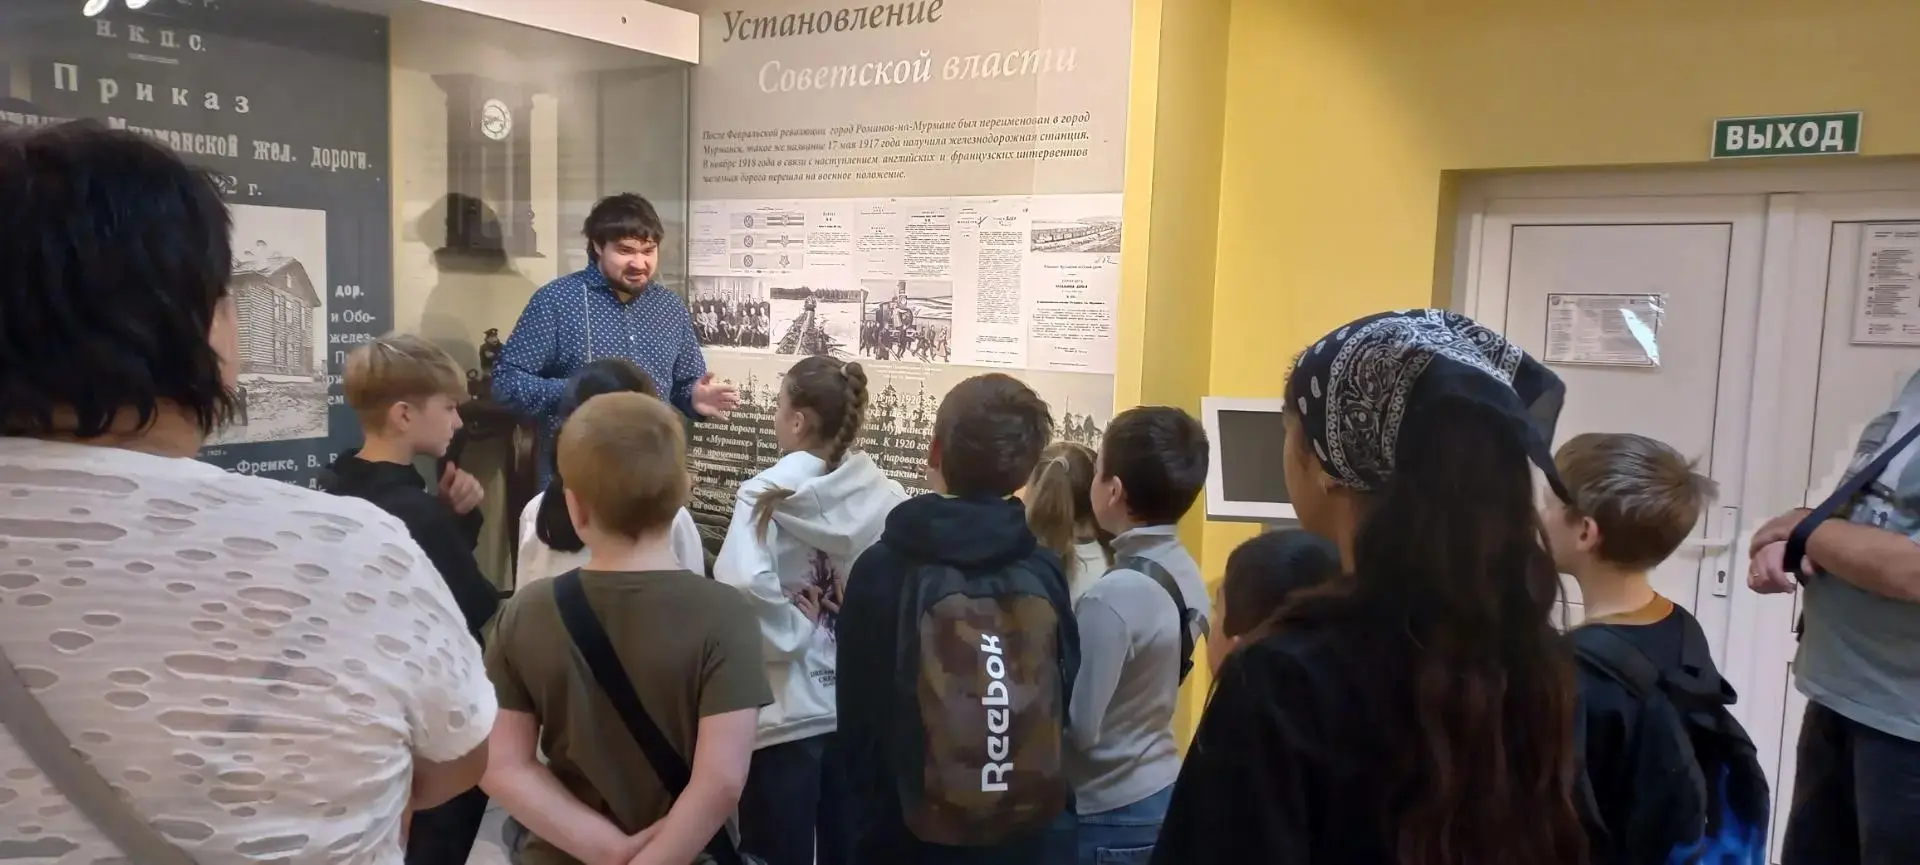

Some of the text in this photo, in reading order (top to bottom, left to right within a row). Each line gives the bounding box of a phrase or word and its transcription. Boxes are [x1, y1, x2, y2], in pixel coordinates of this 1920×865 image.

[723, 0, 944, 43] Установление
[758, 47, 1078, 94] Советской власти
[829, 124, 855, 137] город
[856, 120, 956, 135] Романов-на-Мурмане
[957, 118, 977, 129] был
[979, 115, 1050, 130] переименован
[1052, 115, 1060, 124] в
[1061, 111, 1091, 126] город
[827, 140, 838, 150] 17
[840, 141, 857, 150] мая
[858, 138, 880, 150] 1917
[880, 137, 900, 149] года
[902, 137, 947, 150] получила
[948, 133, 1038, 146] железнодорожная
[1039, 131, 1090, 142] станция.
[1725, 119, 1844, 152] ВЫХОД
[252, 140, 297, 163] жел.
[310, 145, 373, 172] дороги.
[739, 158, 757, 168] 1918
[814, 154, 878, 168] наступлением
[882, 152, 936, 163] английских
[939, 153, 946, 162] и
[950, 149, 1014, 164] французских
[1016, 147, 1089, 160] интервентов
[805, 172, 816, 181] на
[817, 171, 852, 181] военное
[855, 169, 906, 180] положение.
[334, 284, 365, 299] дор.
[342, 309, 377, 323] Обо-
[730, 421, 756, 434] дорога
[756, 439, 778, 450] было
[894, 438, 916, 449] 1920
[980, 633, 1014, 793] Reebok
